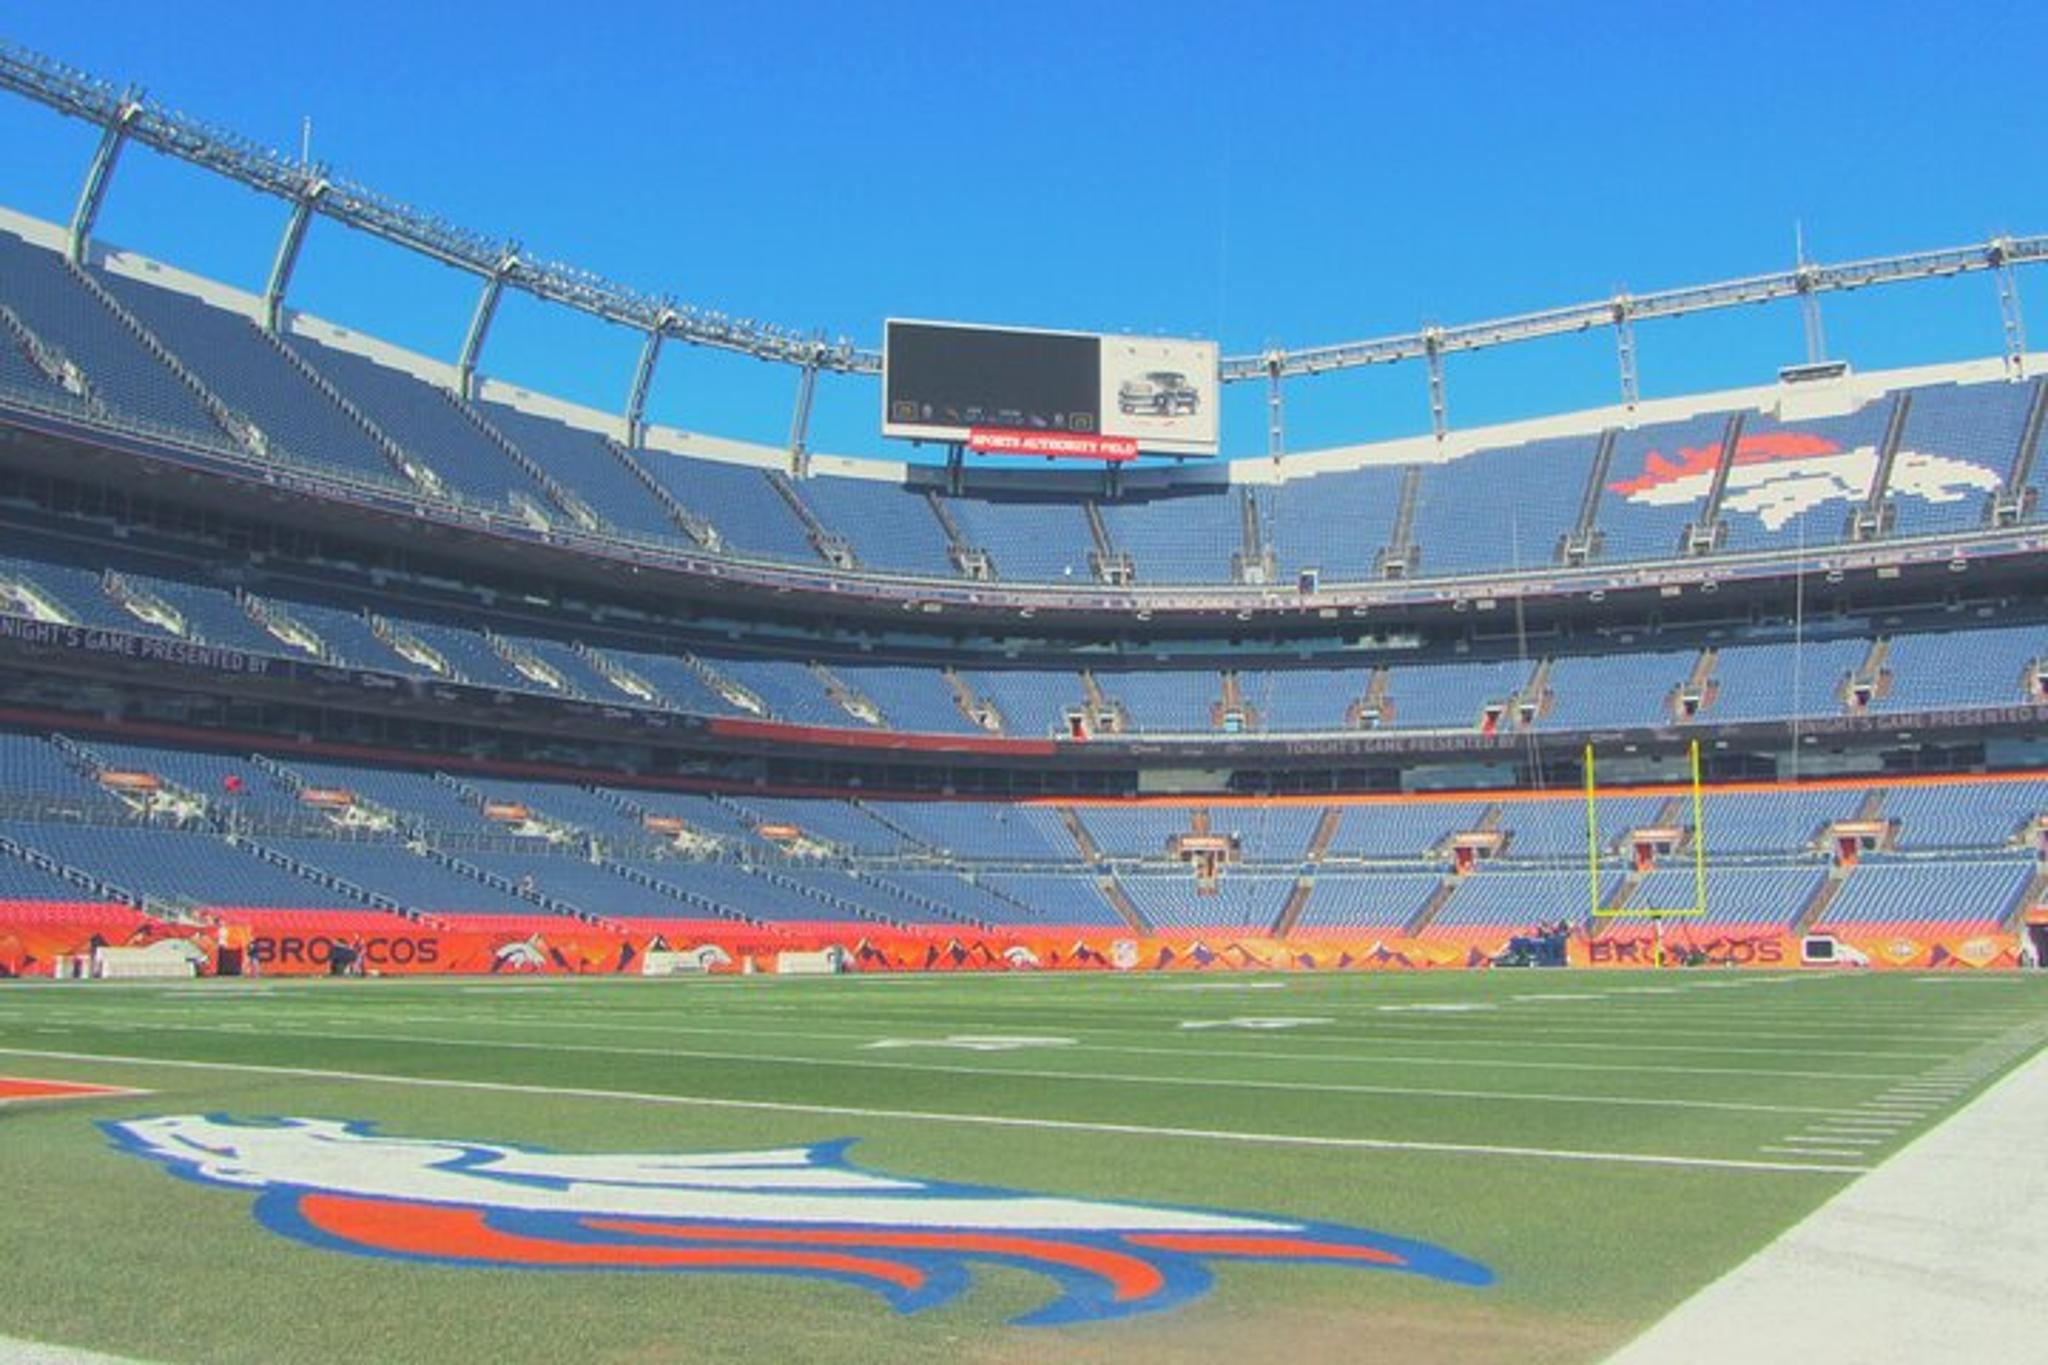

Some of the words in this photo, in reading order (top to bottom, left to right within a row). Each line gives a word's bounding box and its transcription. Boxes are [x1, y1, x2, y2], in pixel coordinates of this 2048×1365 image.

[972, 434, 1020, 449] SPORTS
[1023, 437, 1098, 453] AUTHORITY
[1101, 443, 1136, 457] FIELD
[84, 629, 136, 655] GAME
[141, 639, 243, 670] PRESENTED
[249, 656, 269, 673] BY
[1364, 738, 1405, 753] GAME
[249, 936, 437, 964] BROCOS
